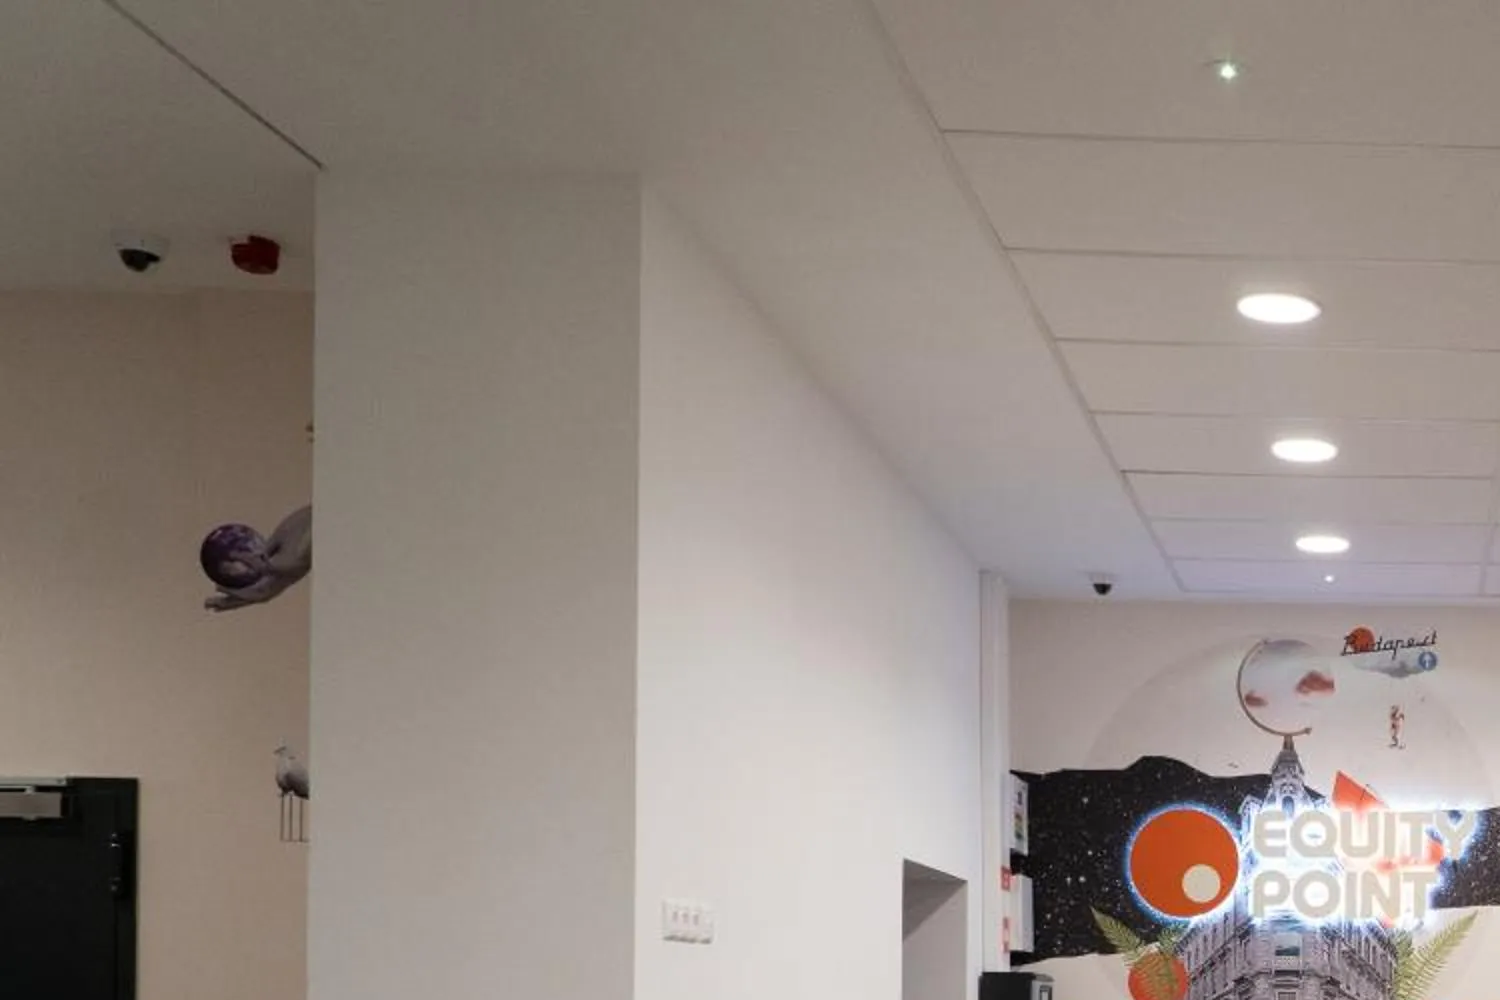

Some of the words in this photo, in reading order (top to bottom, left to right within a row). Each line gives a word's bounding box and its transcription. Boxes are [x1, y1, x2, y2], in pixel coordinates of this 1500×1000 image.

[1340, 628, 1438, 660] Budapest
[1253, 809, 1475, 858] EQUITY
[1253, 869, 1437, 919] POINT
